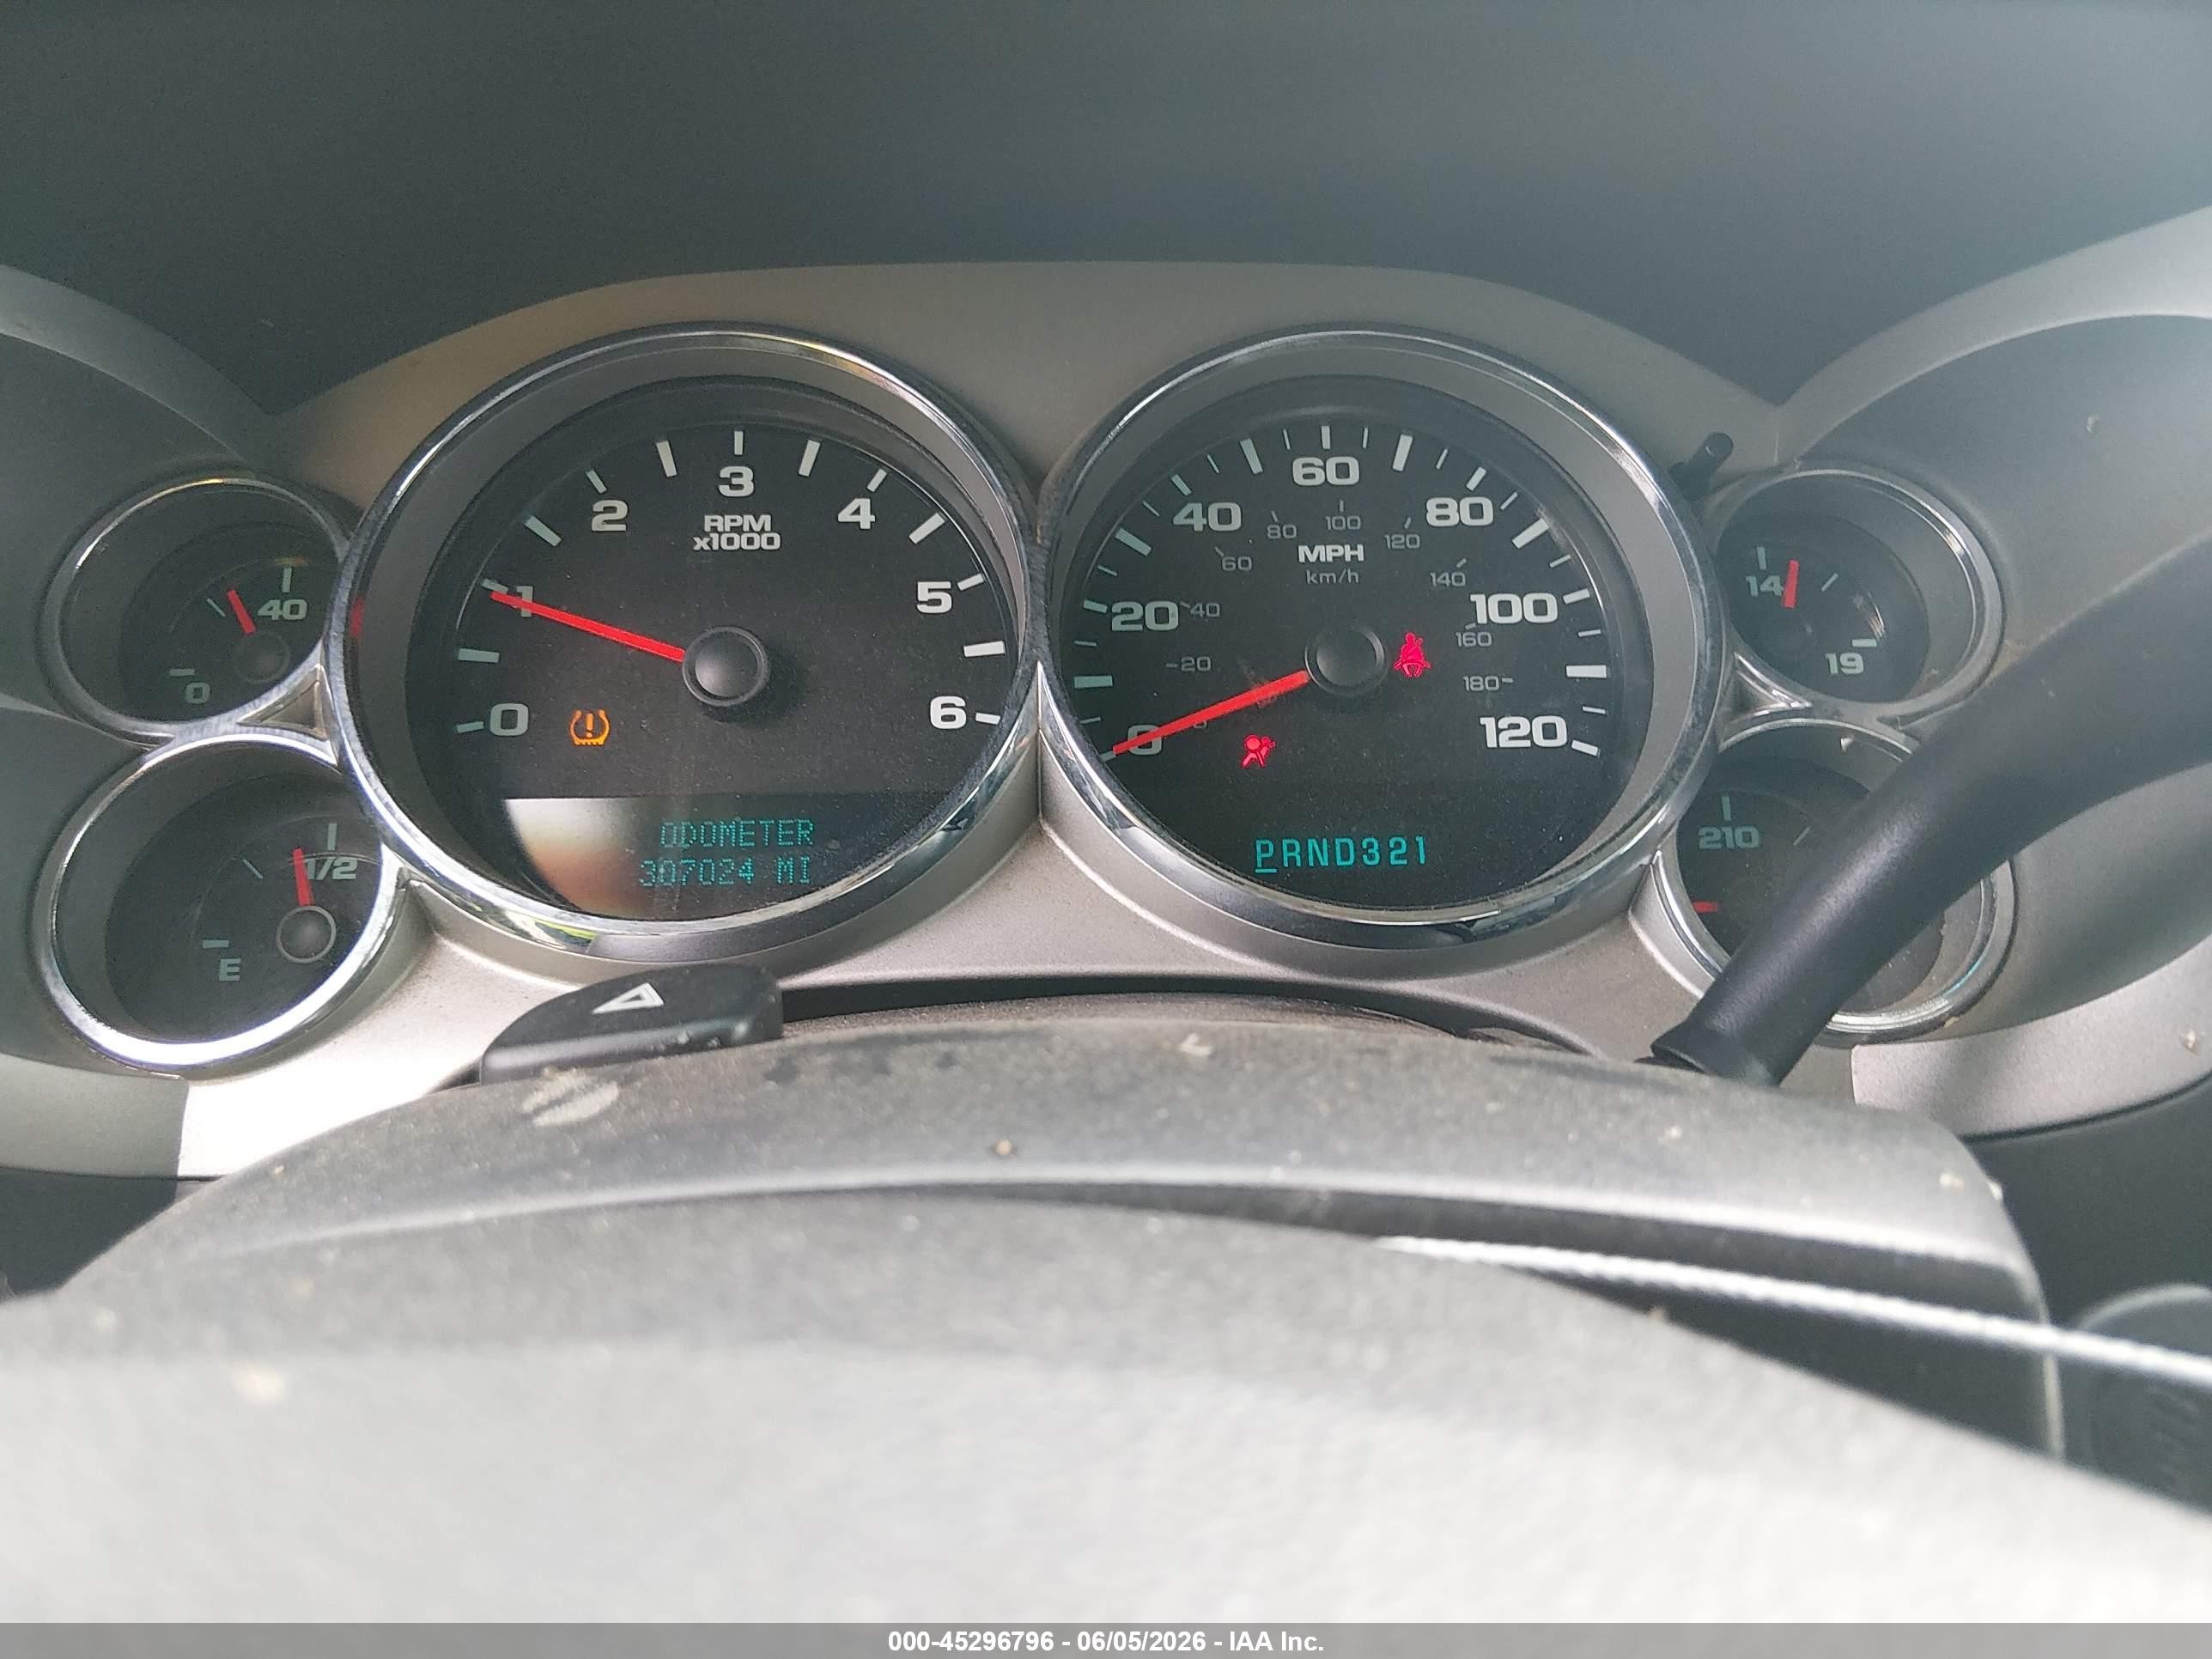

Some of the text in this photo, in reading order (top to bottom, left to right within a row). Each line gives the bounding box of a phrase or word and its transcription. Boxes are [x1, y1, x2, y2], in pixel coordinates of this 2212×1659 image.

[719, 466, 755, 497] 3
[1292, 456, 1359, 486] 60
[591, 500, 629, 532] 2
[703, 514, 771, 532] RPM
[837, 498, 876, 530] 4
[1173, 502, 1241, 532] 40
[1325, 515, 1361, 531] 100
[1425, 497, 1493, 527] 80
[693, 533, 781, 552] x1000
[1266, 523, 1297, 540] 80
[1384, 533, 1420, 550] 120
[1221, 556, 1252, 572] 60
[1298, 544, 1364, 562] MPH
[1306, 568, 1359, 585] km/h
[1430, 572, 1466, 587] 140
[1746, 575, 1784, 598] 14
[916, 581, 952, 614] 5
[1470, 592, 1558, 624] 100
[258, 598, 307, 621] 40
[1111, 601, 1179, 631] 20
[1189, 602, 1220, 617] 40
[1455, 632, 1492, 647] 160
[1180, 656, 1211, 672] 20
[1826, 653, 1864, 675] 19
[185, 683, 210, 704] 0
[1463, 676, 1500, 691] 180
[489, 703, 529, 737] 0
[930, 696, 967, 730] 6
[1127, 724, 1162, 756] 0
[1480, 716, 1566, 749] 120
[660, 819, 814, 848] ODOMETER
[1698, 827, 1760, 849] 210
[304, 856, 357, 880] 1/2
[639, 856, 811, 886] 307024 MI
[218, 958, 241, 981] E
